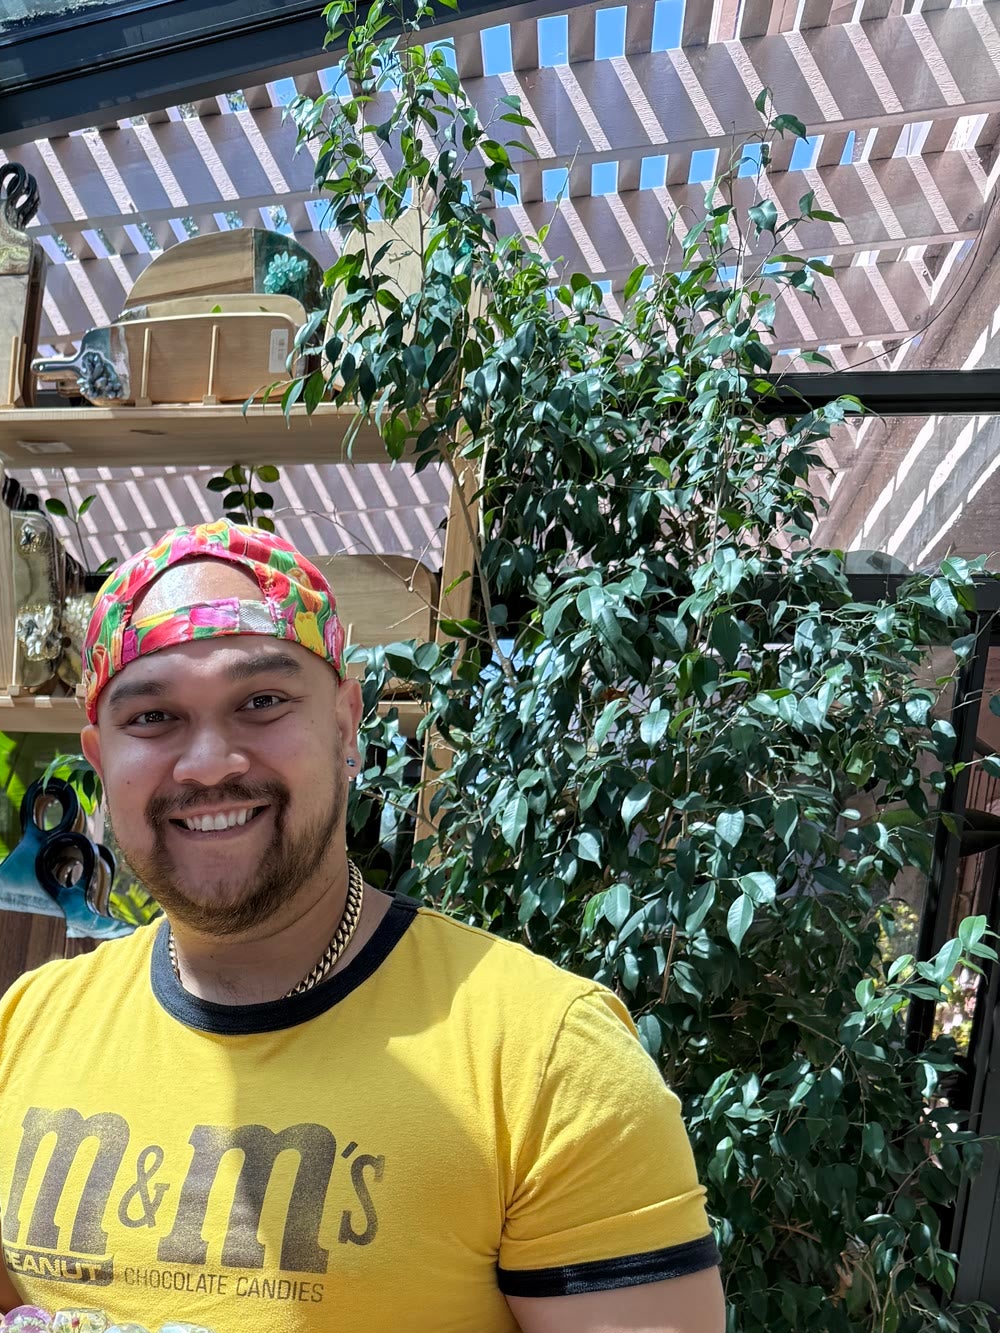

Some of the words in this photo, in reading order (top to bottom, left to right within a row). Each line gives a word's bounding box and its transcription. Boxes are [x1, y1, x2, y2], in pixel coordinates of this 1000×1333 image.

[3, 1250, 101, 1281] PEANUT
[123, 1266, 228, 1296] CHOCOLATE
[236, 1276, 325, 1303] CANDIES
